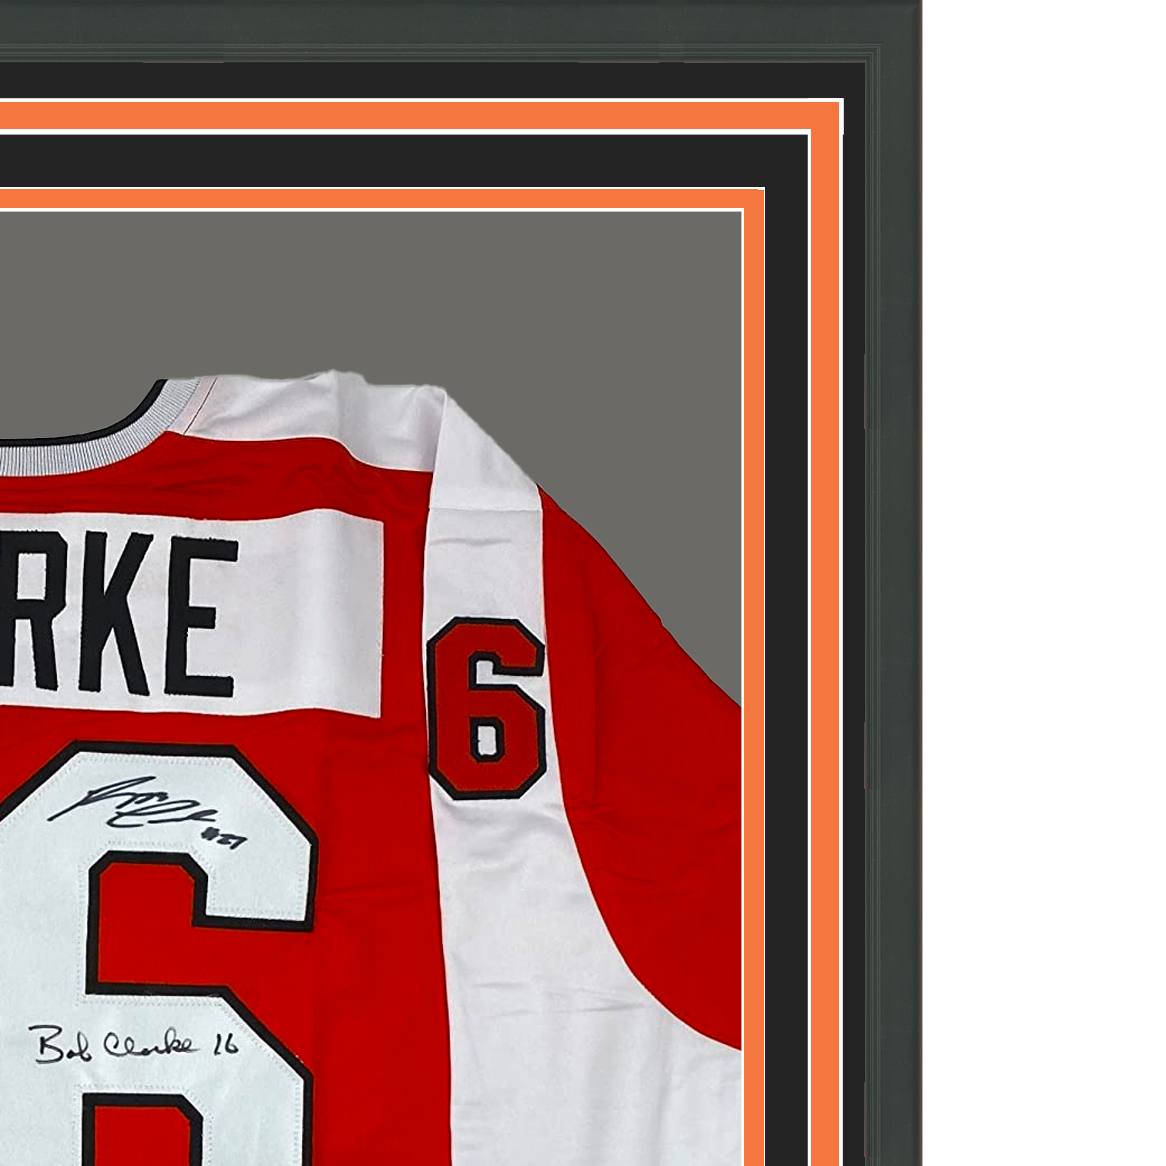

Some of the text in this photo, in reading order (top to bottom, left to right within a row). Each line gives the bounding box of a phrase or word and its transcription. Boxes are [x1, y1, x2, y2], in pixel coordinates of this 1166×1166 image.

[426, 616, 547, 800] 6
[29, 1025, 239, 1064] Bob Clarke 16
